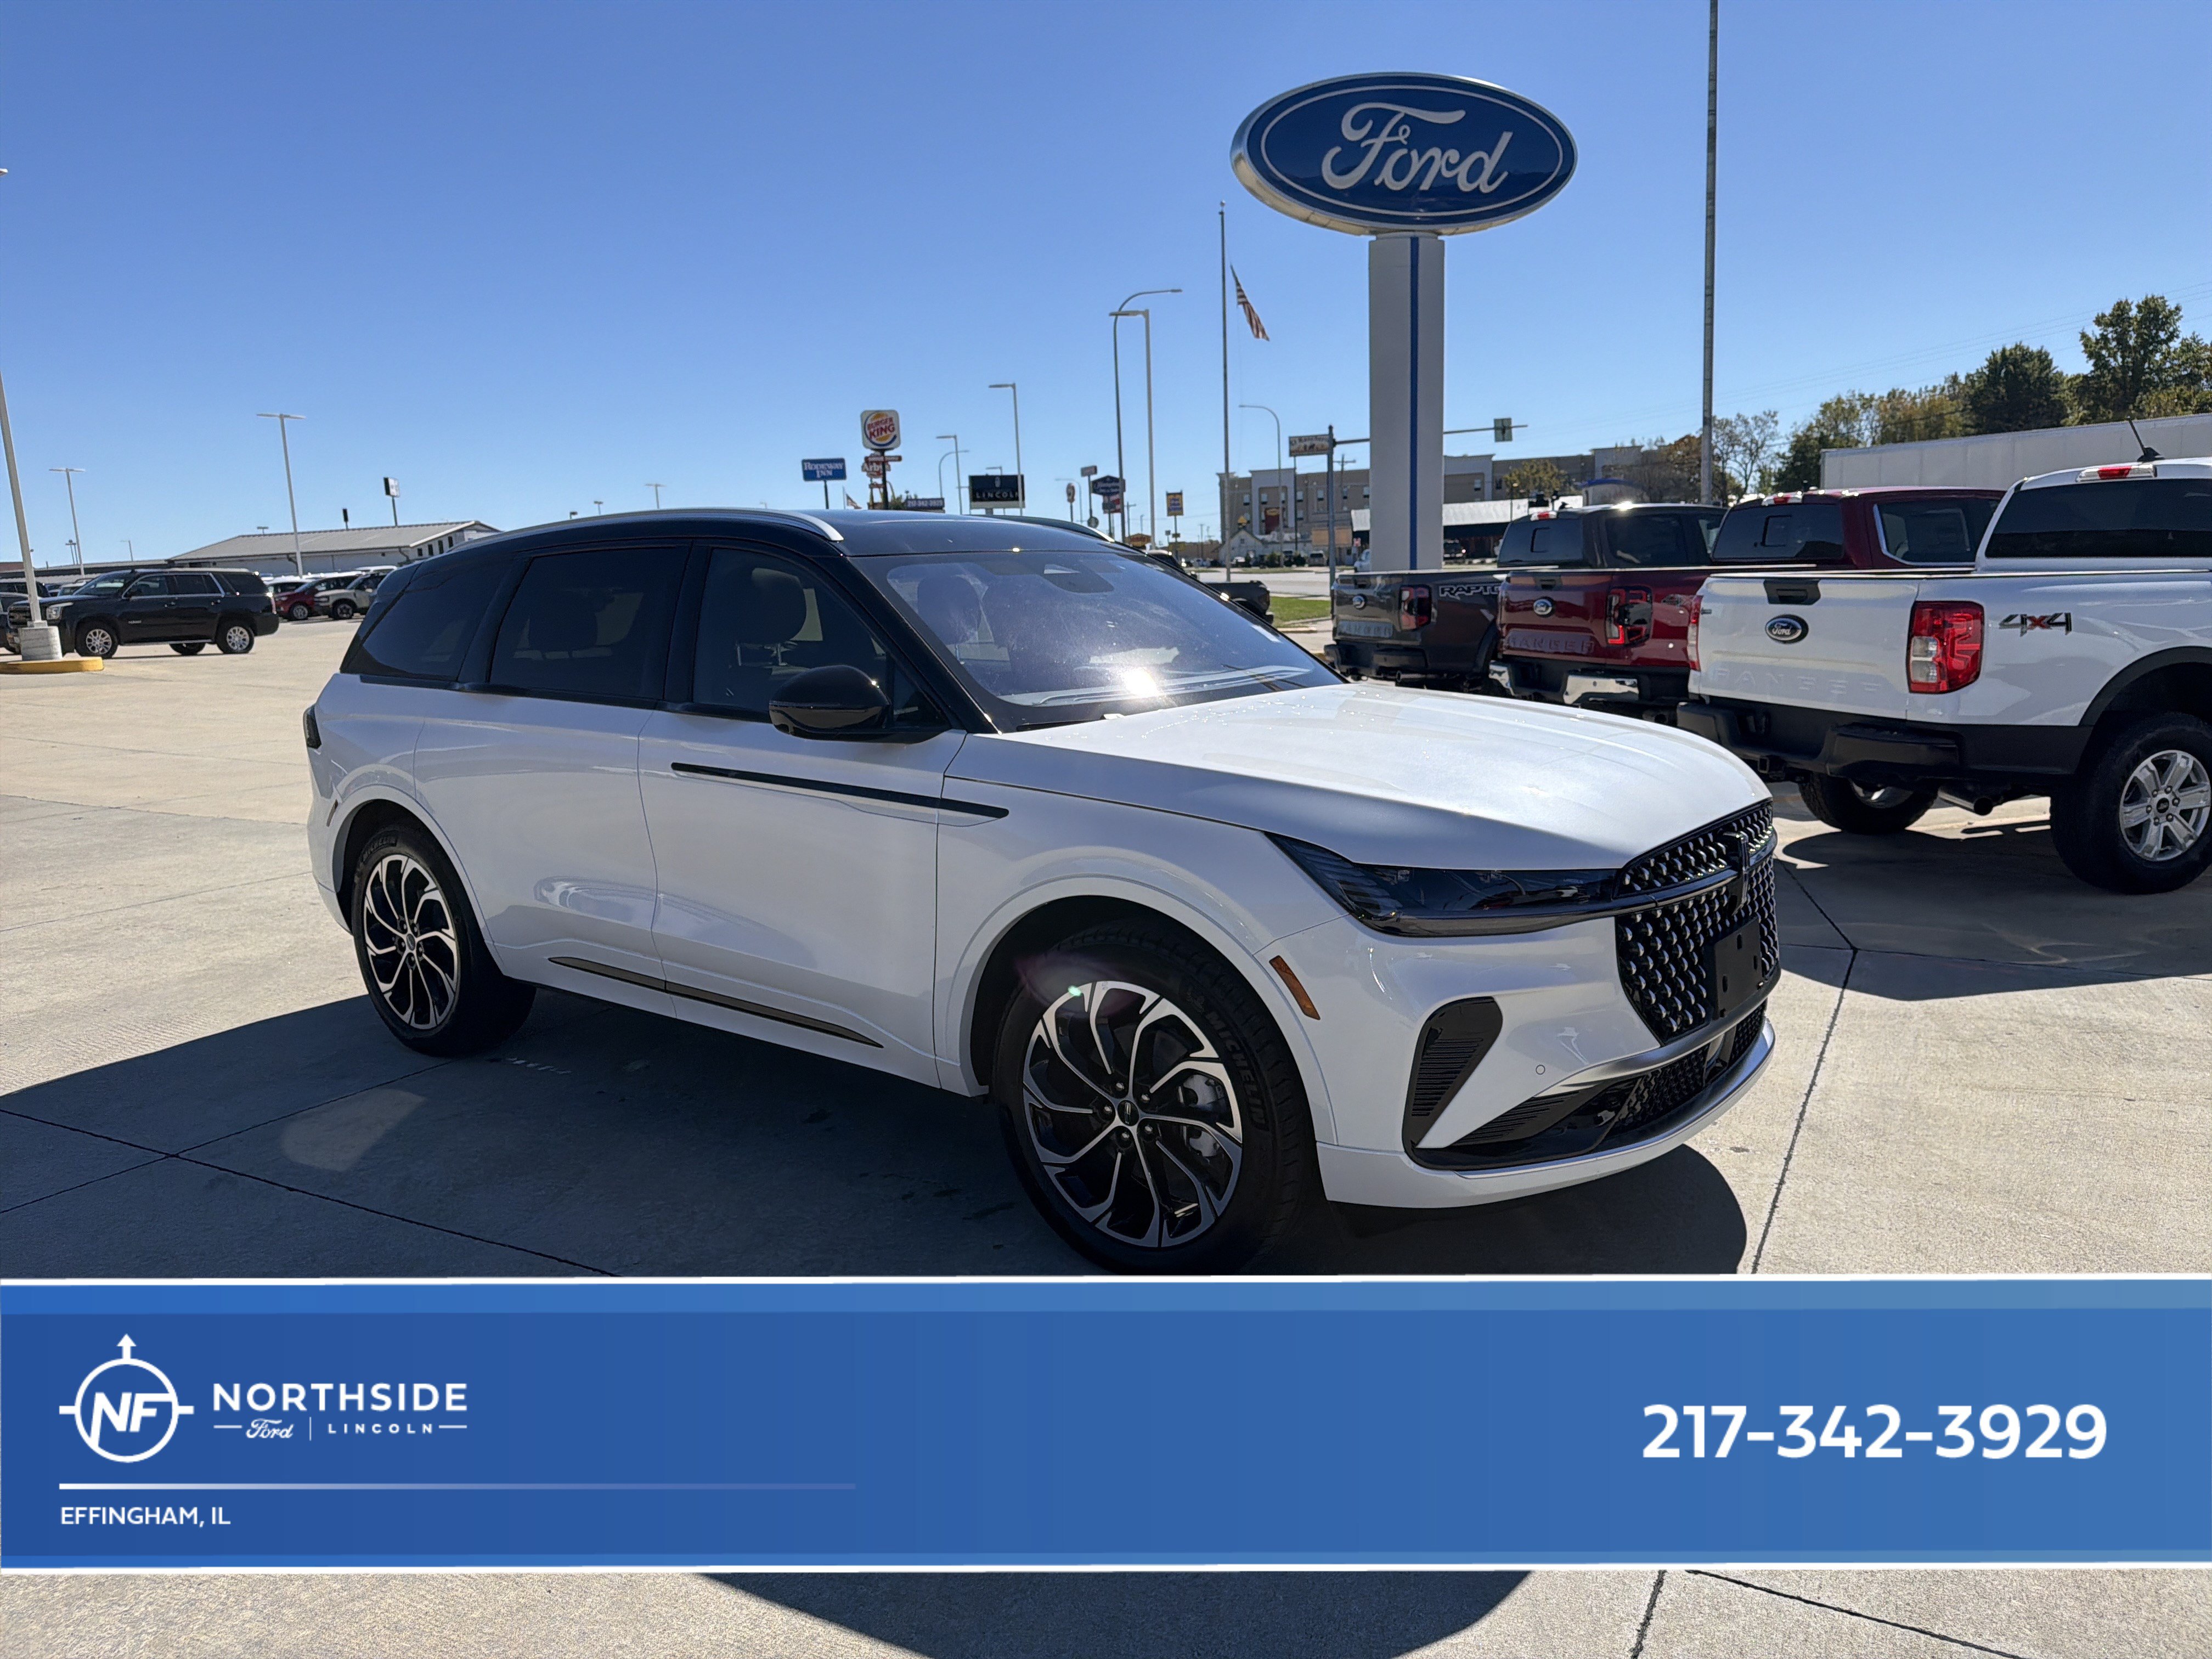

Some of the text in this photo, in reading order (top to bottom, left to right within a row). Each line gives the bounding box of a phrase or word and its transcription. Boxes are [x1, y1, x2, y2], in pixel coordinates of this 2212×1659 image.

[1321, 101, 1514, 193] Ford
[867, 417, 893, 431] BURGER
[869, 424, 895, 439] KING
[1439, 584, 1500, 600] RAPTO
[1771, 622, 1792, 635] Ford
[1999, 612, 2072, 637] 4x4
[1510, 634, 1595, 655] RANGER
[1206, 1011, 1266, 1125] MICHELIN
